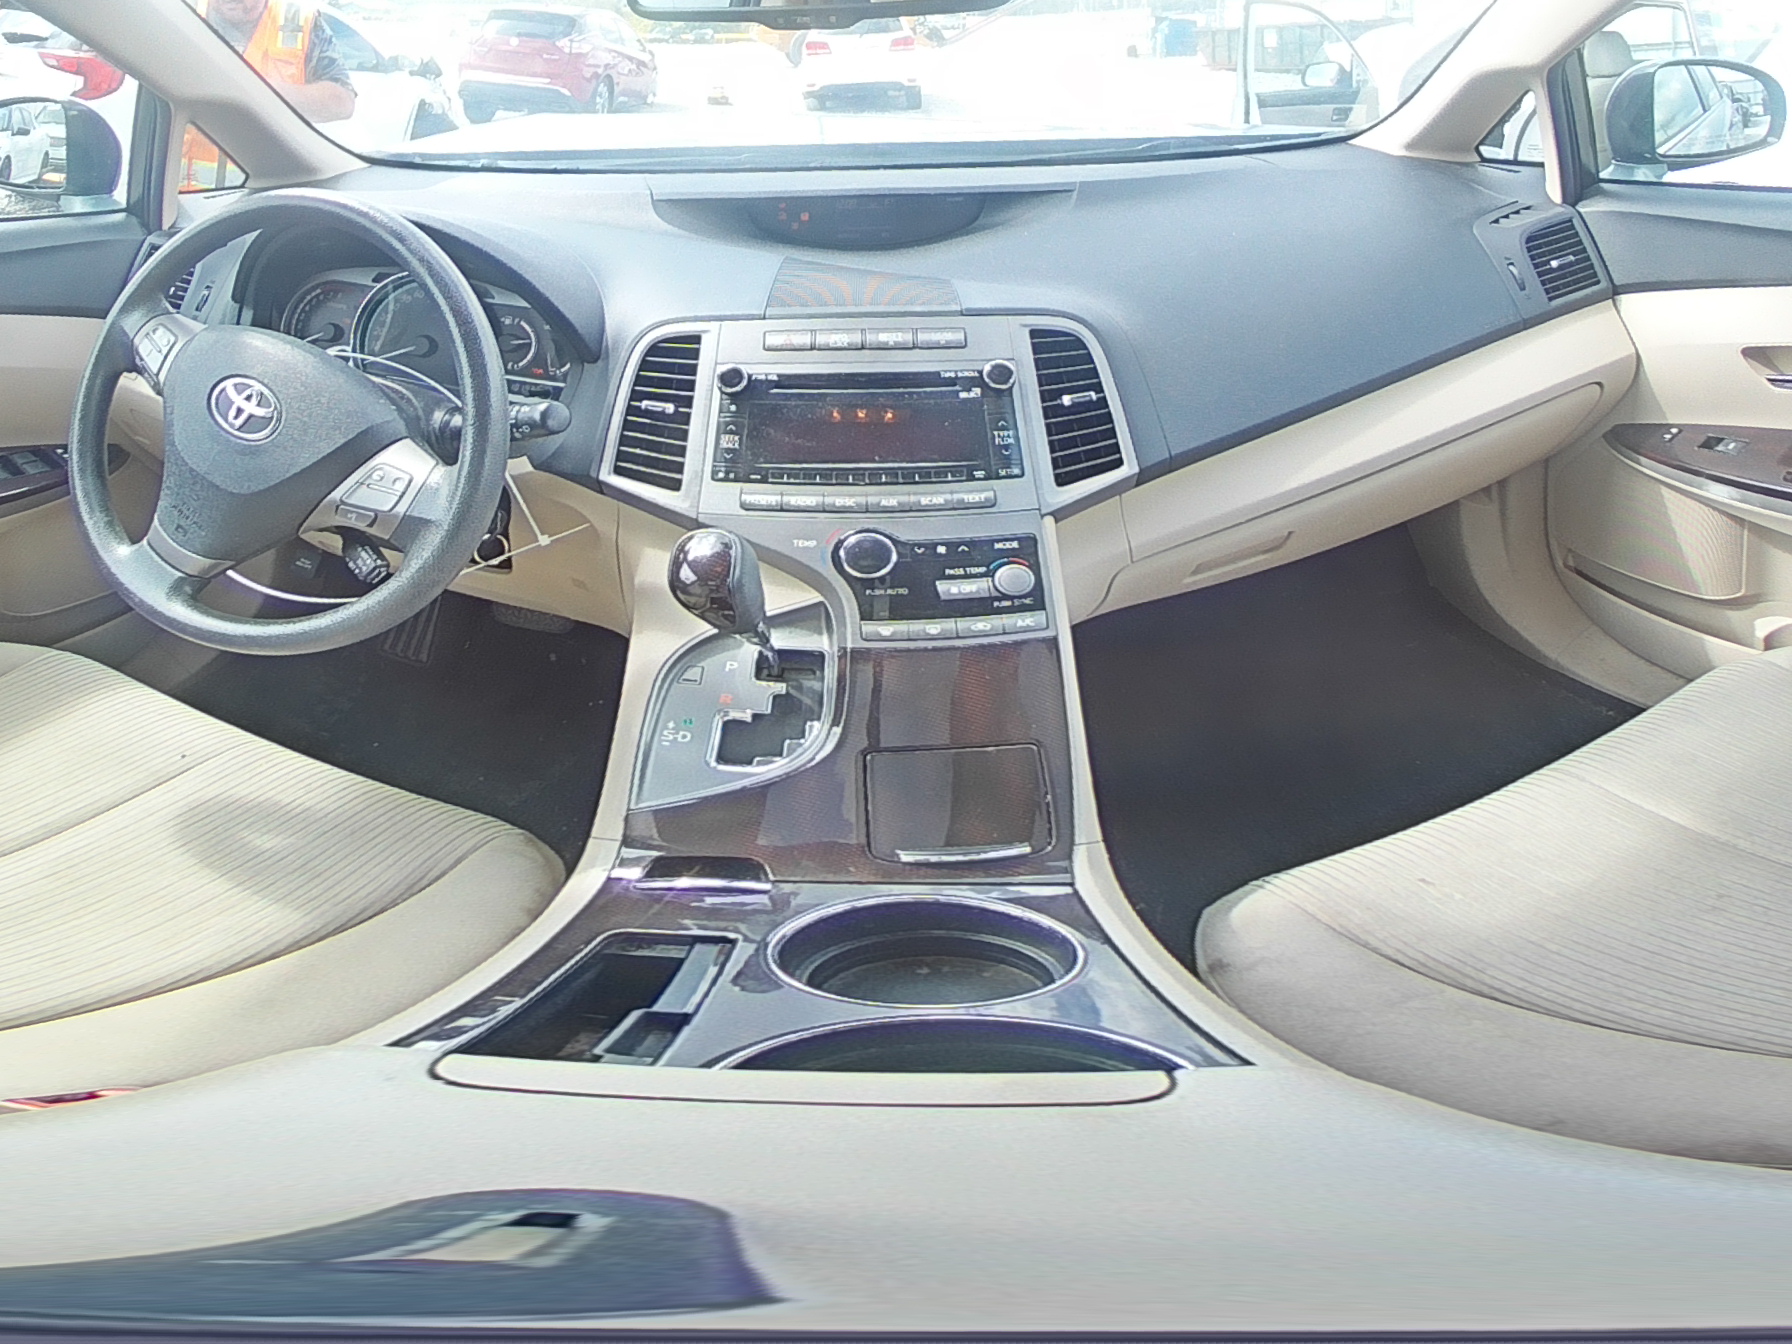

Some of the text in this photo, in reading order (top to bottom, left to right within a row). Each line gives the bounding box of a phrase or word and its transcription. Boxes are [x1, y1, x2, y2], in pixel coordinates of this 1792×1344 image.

[790, 497, 816, 506] RADIO
[835, 497, 857, 507] DISC
[880, 498, 898, 506] AUX
[920, 496, 945, 505] SCAN
[964, 495, 985, 503] TEXT
[792, 539, 818, 548] TEMP
[994, 540, 1020, 550] MODE
[965, 566, 987, 575] TEMP
[886, 587, 909, 595] AUTO
[960, 584, 978, 593] OFF
[1016, 617, 1035, 628] A/C
[725, 661, 739, 672] P
